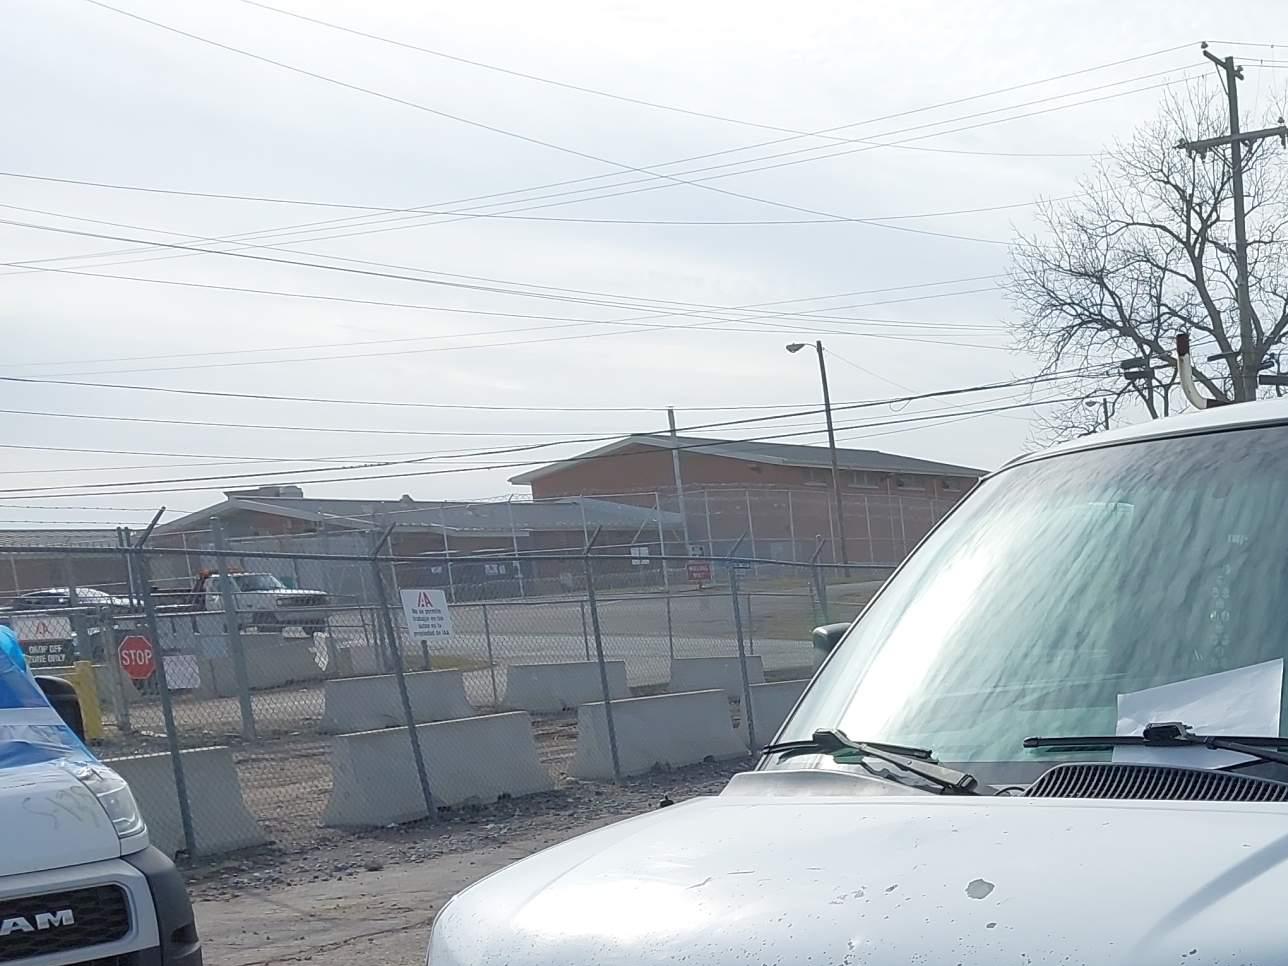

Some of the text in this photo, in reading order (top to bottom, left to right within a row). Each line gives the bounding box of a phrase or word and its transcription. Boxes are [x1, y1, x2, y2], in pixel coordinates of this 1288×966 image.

[29, 645, 48, 653] DROP
[47, 654, 66, 662] ONLY
[121, 649, 152, 666] STOP
[0, 909, 75, 936] AM
